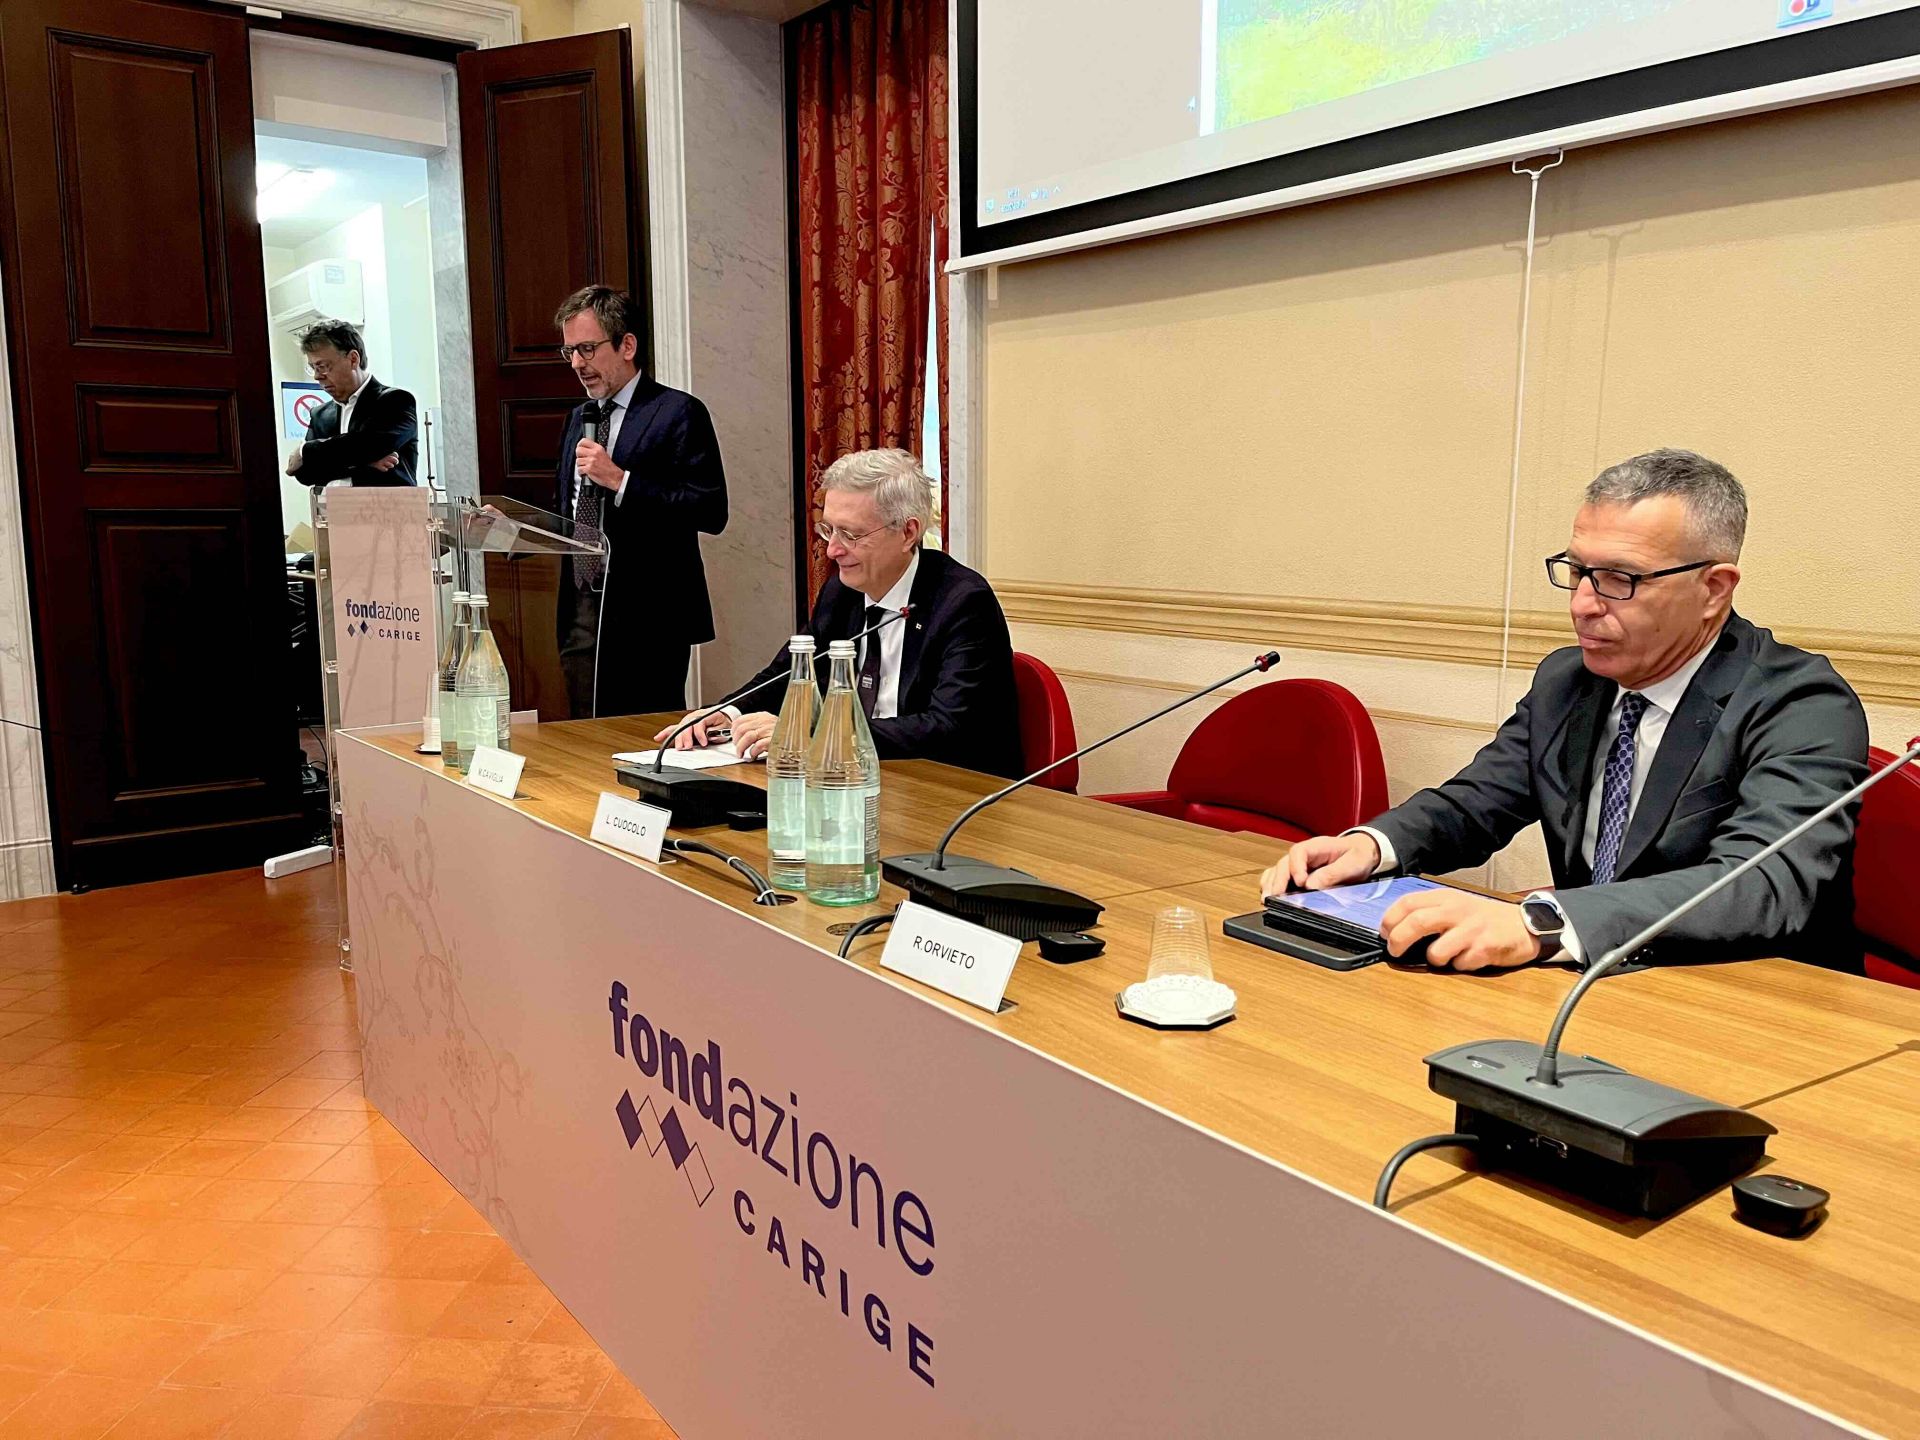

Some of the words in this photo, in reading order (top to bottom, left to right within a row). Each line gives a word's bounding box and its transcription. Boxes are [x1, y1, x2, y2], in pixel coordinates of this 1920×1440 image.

[345, 598, 420, 623] fondazione
[378, 628, 421, 641] CARIGE
[608, 980, 936, 1276] fondazione
[733, 1189, 935, 1389] CARIGE
